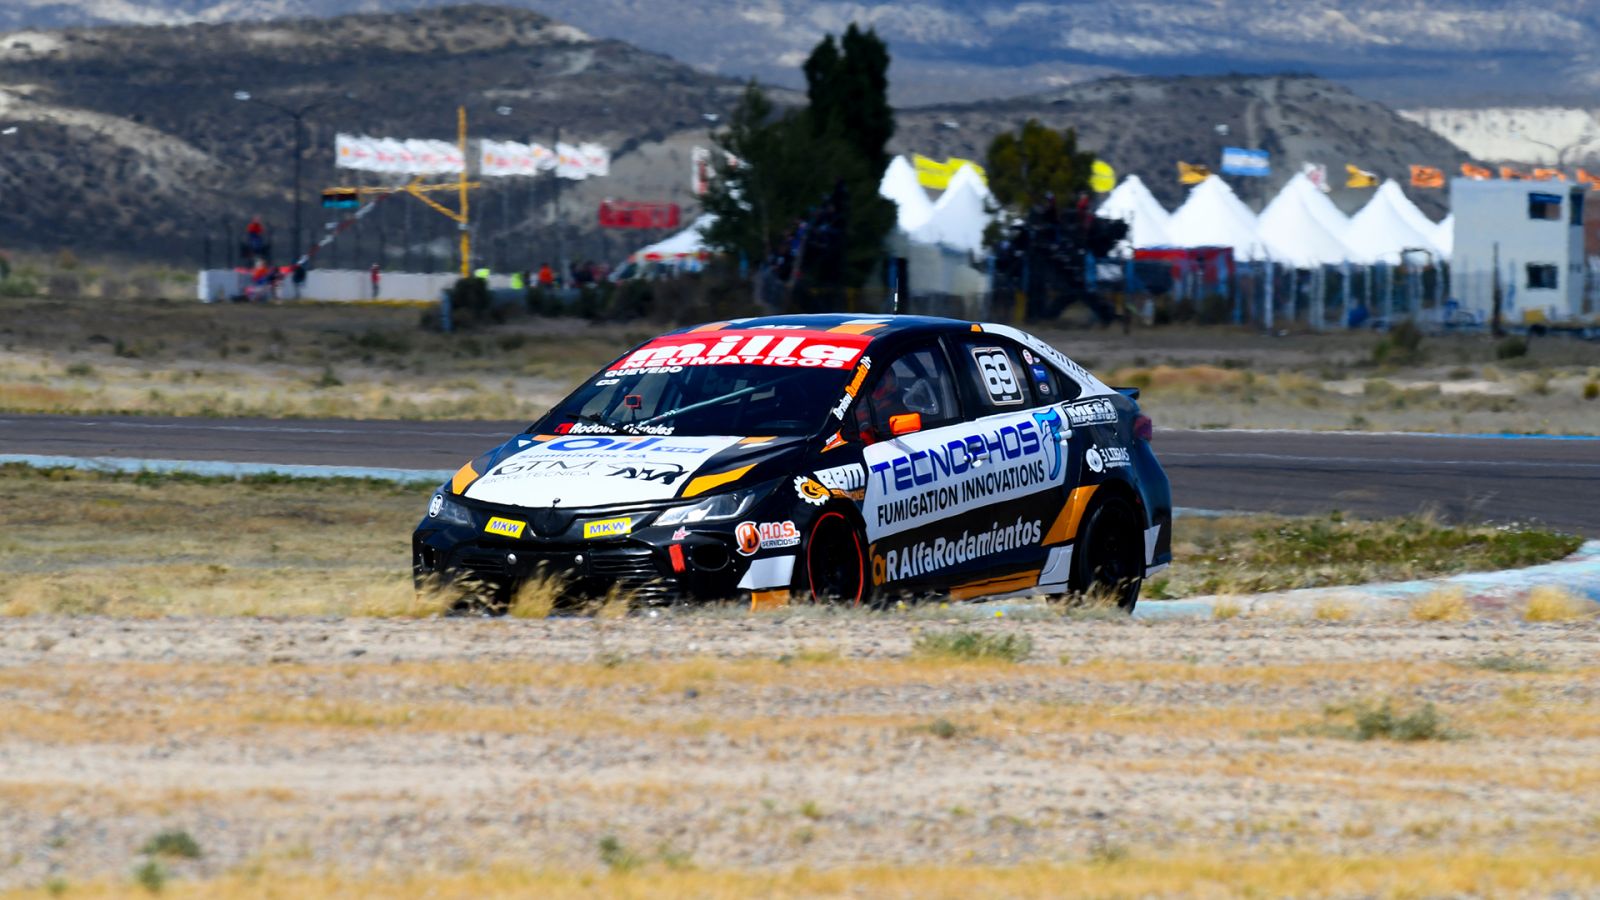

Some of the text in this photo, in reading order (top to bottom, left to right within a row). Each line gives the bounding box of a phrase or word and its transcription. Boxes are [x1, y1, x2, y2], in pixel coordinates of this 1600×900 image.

[627, 335, 861, 362] milla
[620, 354, 845, 368] NEUMATICOS
[605, 366, 683, 377] QUEVEDO
[978, 354, 1017, 394] 69
[1066, 401, 1114, 417] MEGA
[547, 437, 664, 450] Oil
[870, 421, 1040, 495] TECNOPHOS
[1100, 449, 1109, 462] 3
[493, 460, 599, 476] GTM
[877, 459, 1045, 527] FUMIGATION INNOVATIONS
[490, 520, 520, 533] MKW
[589, 521, 626, 534] MKW
[761, 522, 799, 540] H.O.S.
